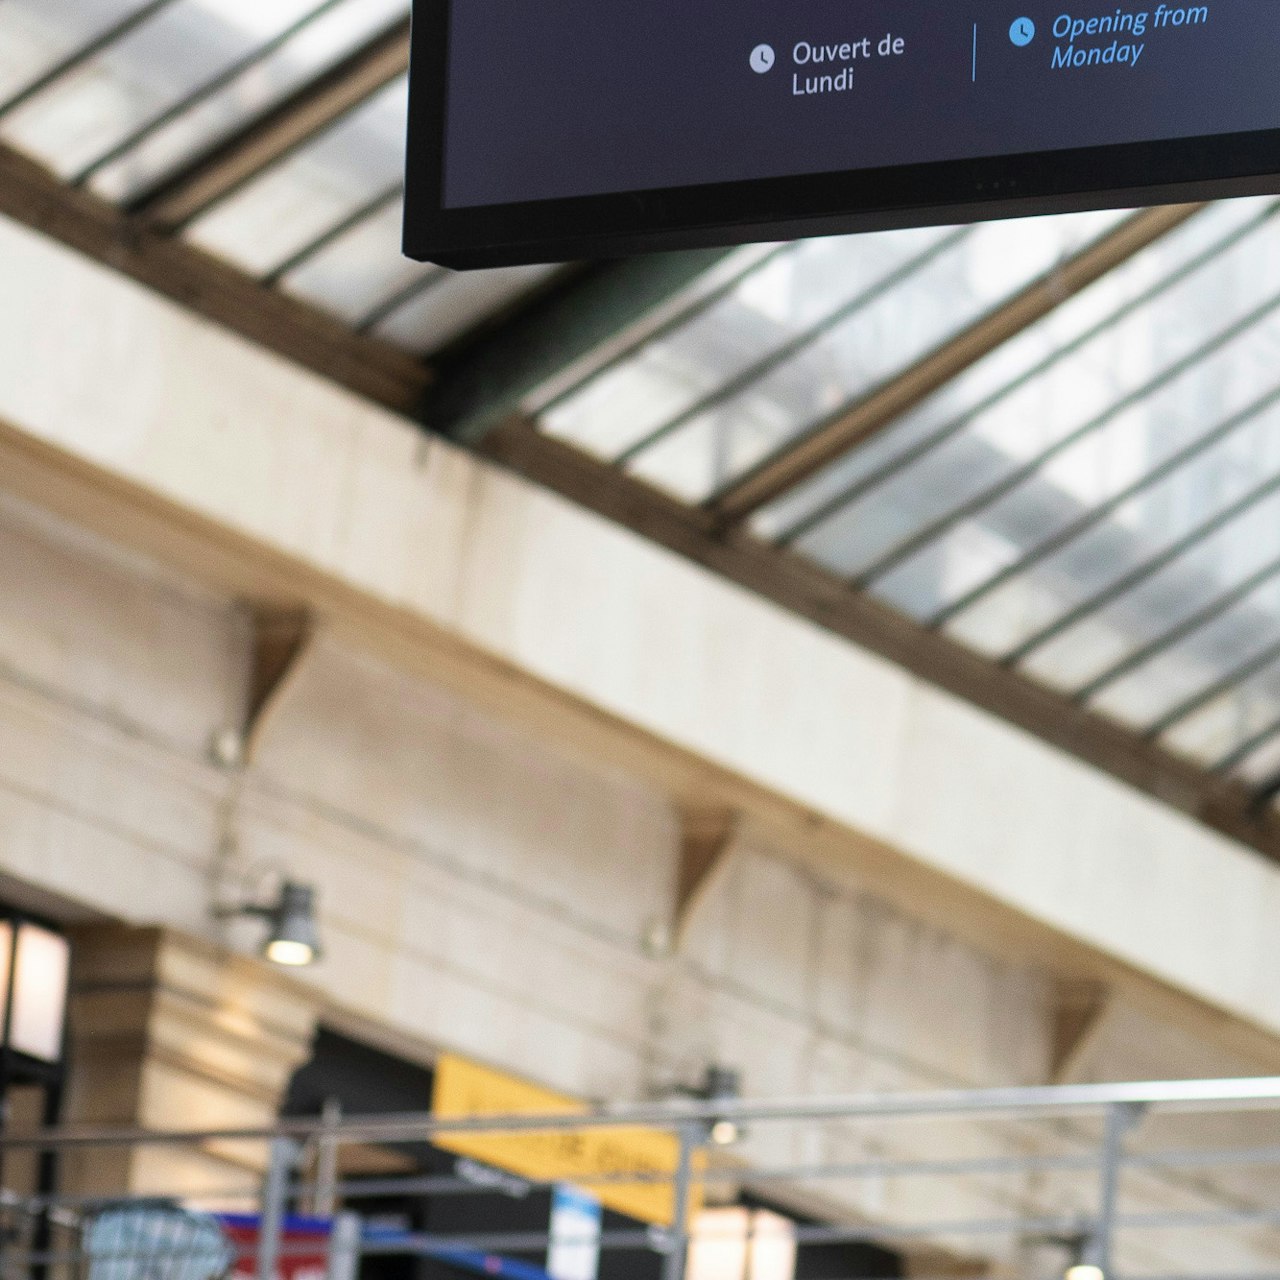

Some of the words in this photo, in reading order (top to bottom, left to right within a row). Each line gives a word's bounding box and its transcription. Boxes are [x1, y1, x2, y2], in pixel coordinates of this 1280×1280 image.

[1052, 8, 1149, 41] Opening
[1153, 4, 1208, 28] from
[792, 37, 871, 65] Ouvert
[877, 32, 905, 56] de
[1051, 41, 1145, 69] Monday
[792, 67, 854, 96] Lundi
